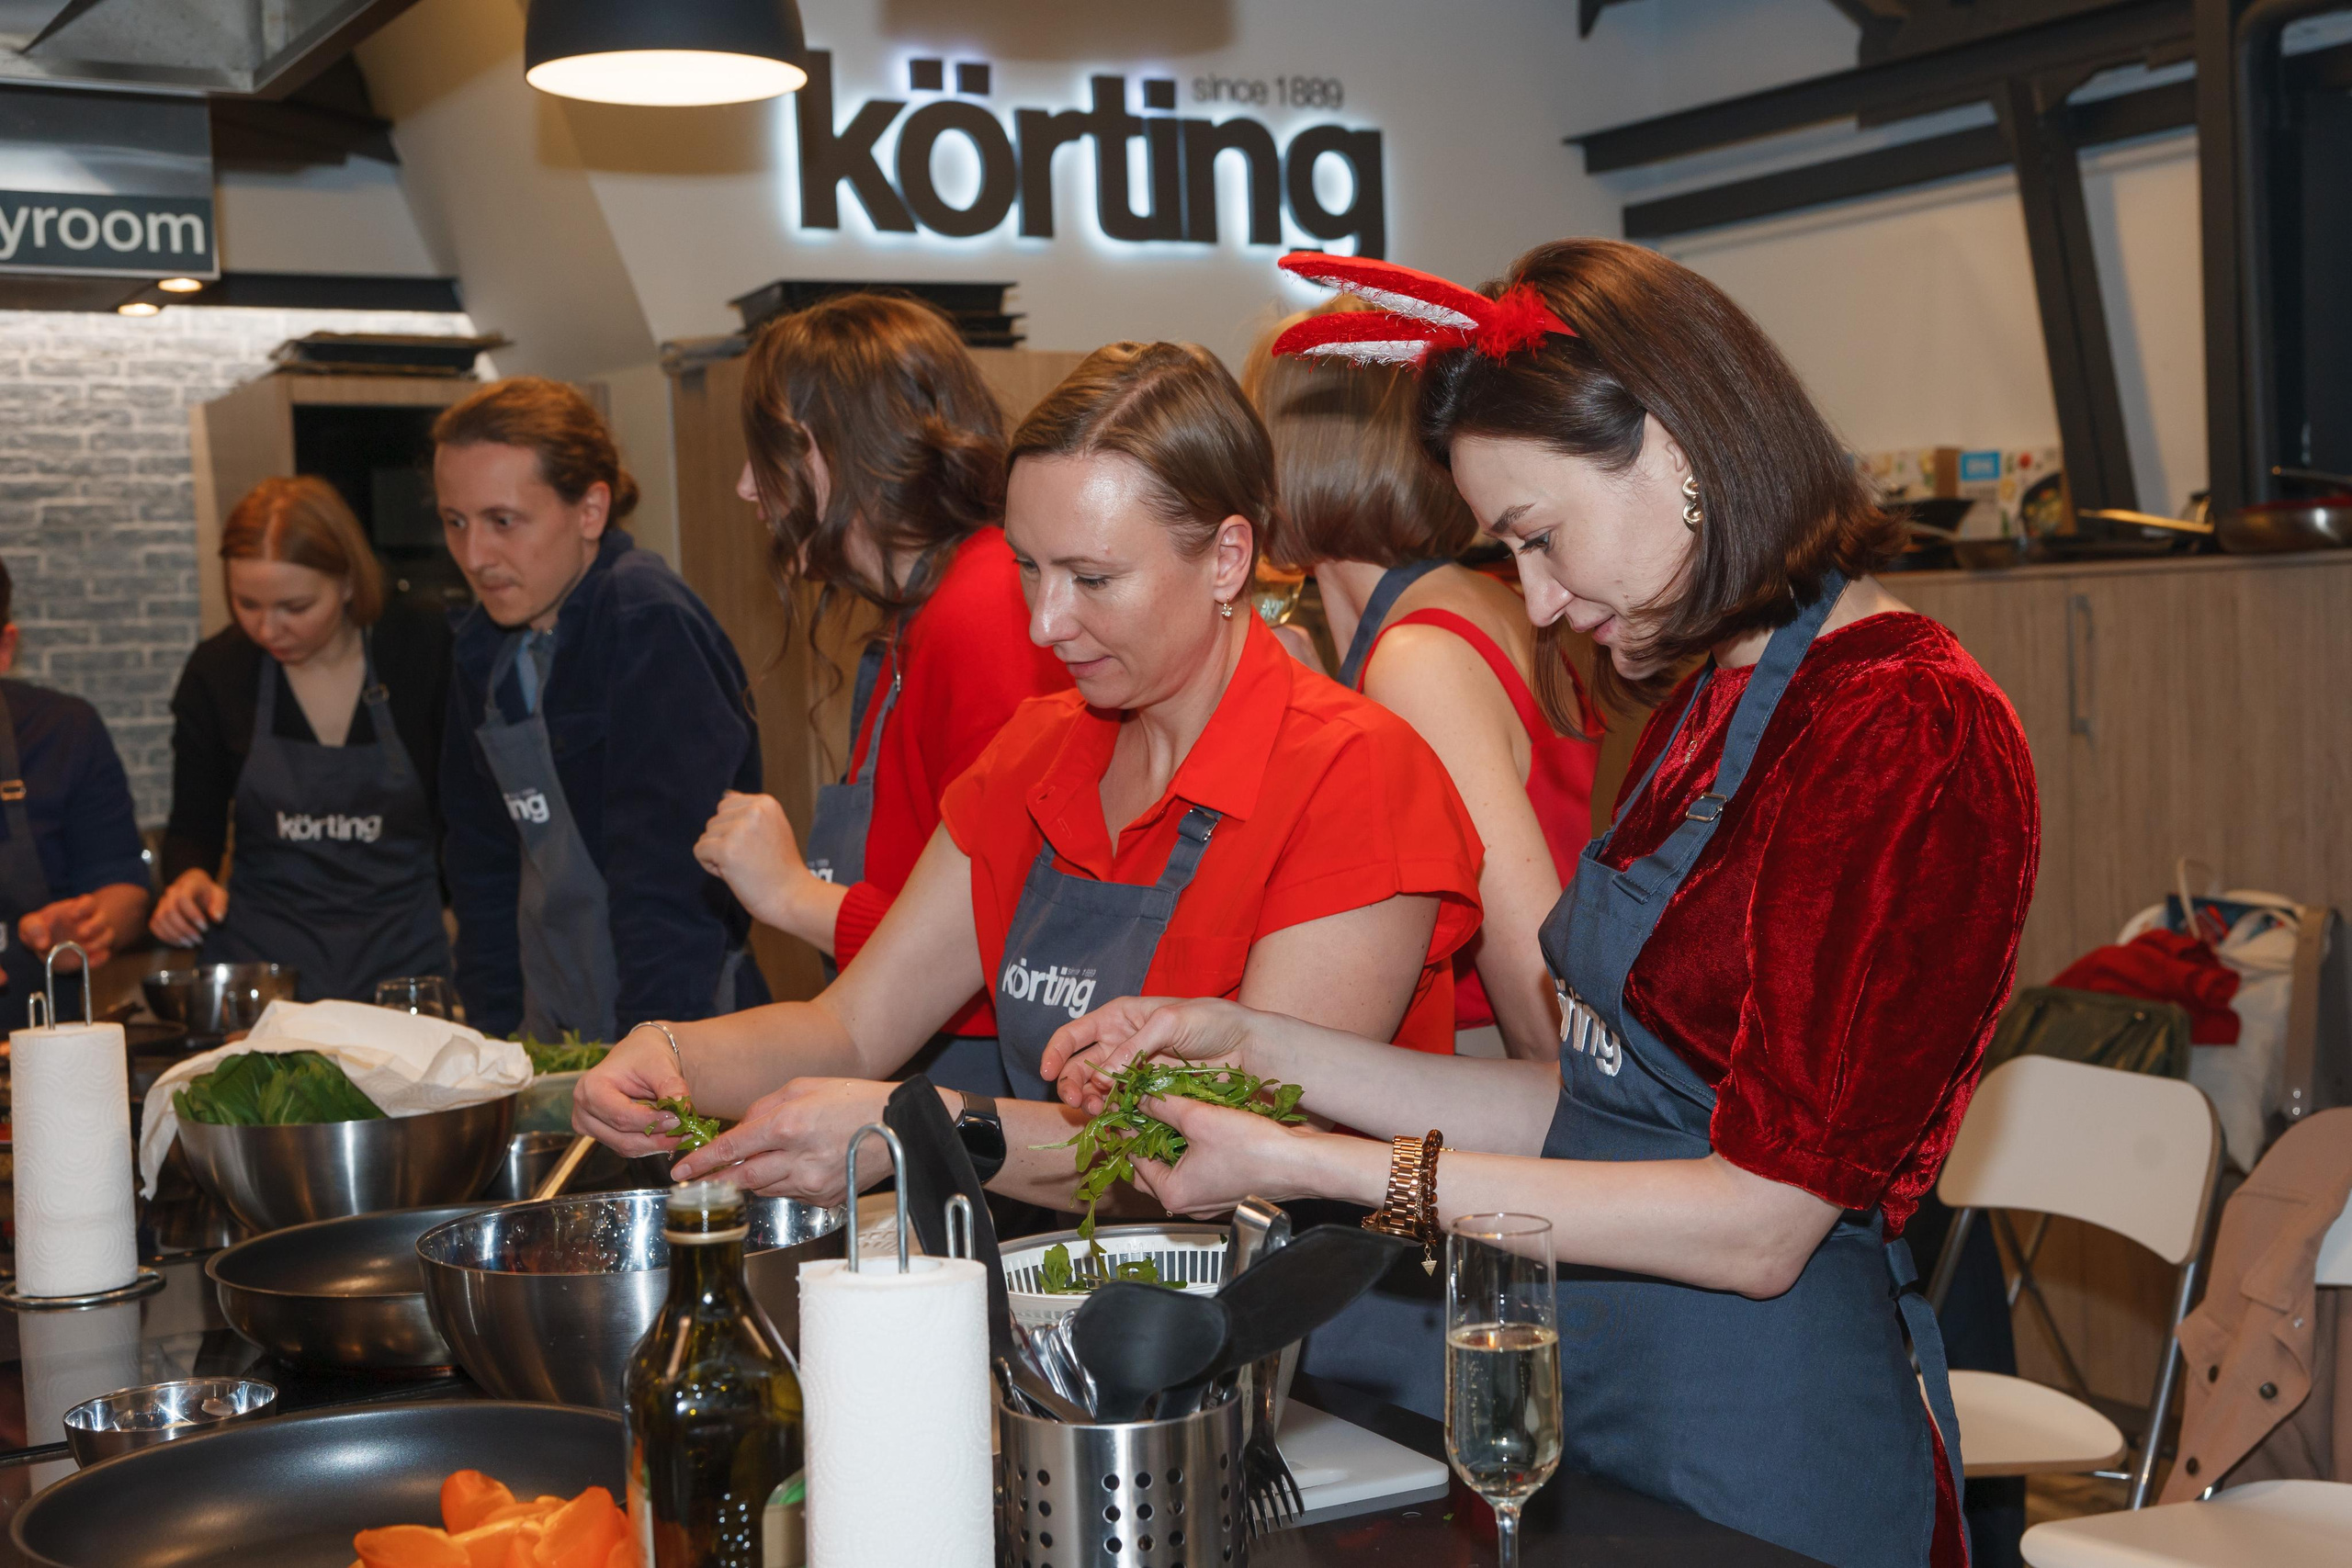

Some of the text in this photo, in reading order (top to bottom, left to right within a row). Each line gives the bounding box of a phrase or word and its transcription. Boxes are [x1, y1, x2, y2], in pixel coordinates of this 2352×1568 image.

[1193, 73, 1345, 110] since 1889
[796, 50, 1386, 287] körting
[277, 811, 382, 843] körting
